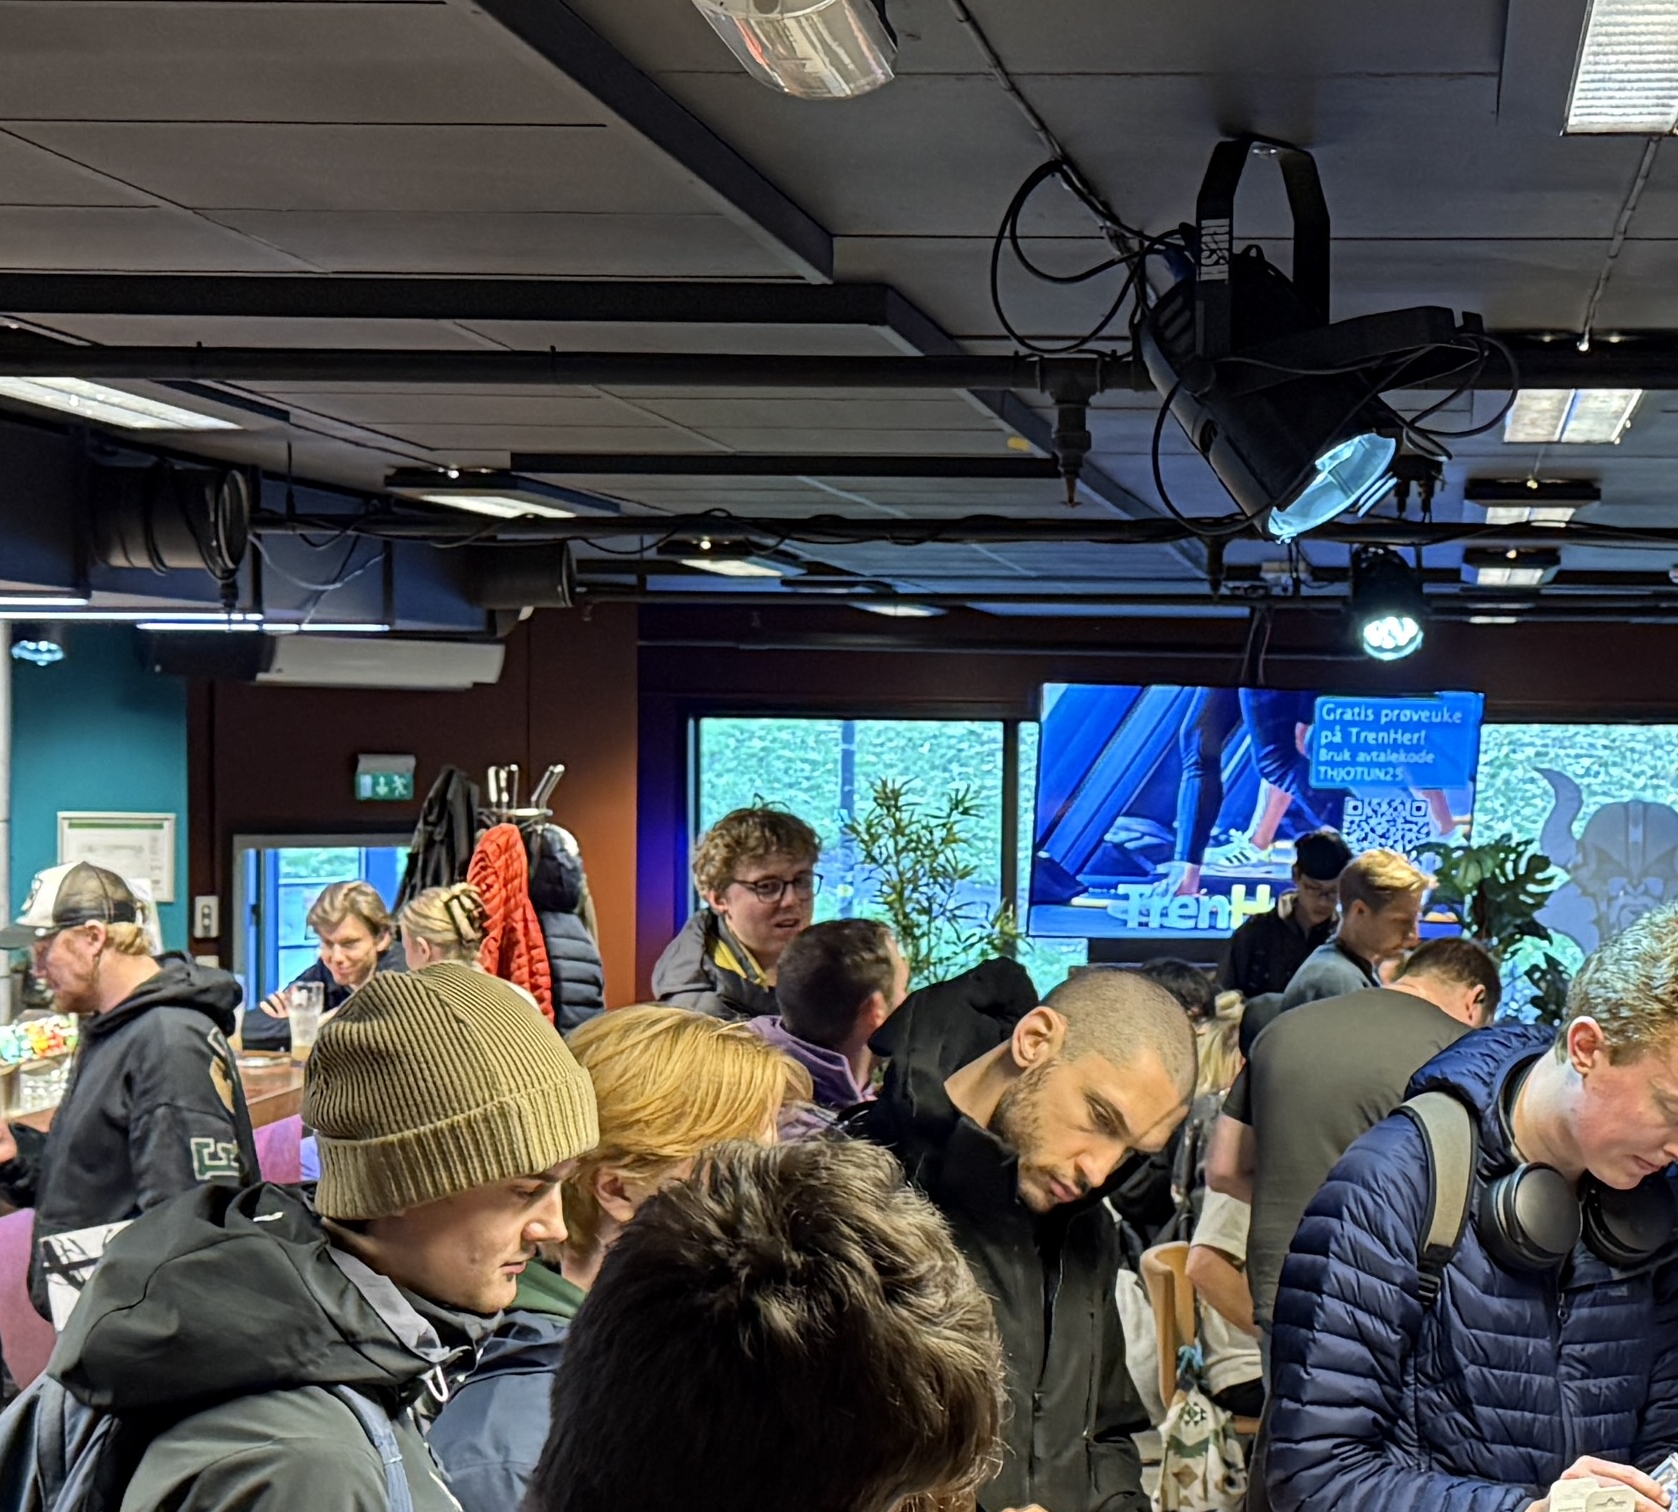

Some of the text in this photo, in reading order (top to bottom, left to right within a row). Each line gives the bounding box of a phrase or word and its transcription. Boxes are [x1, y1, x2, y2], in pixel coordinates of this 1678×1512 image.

[1322, 703, 1464, 725] Gratis prøveuke
[1319, 725, 1343, 746] på
[1318, 748, 1437, 765] Bruk avtalekode
[1117, 883, 1276, 930] TrenH
